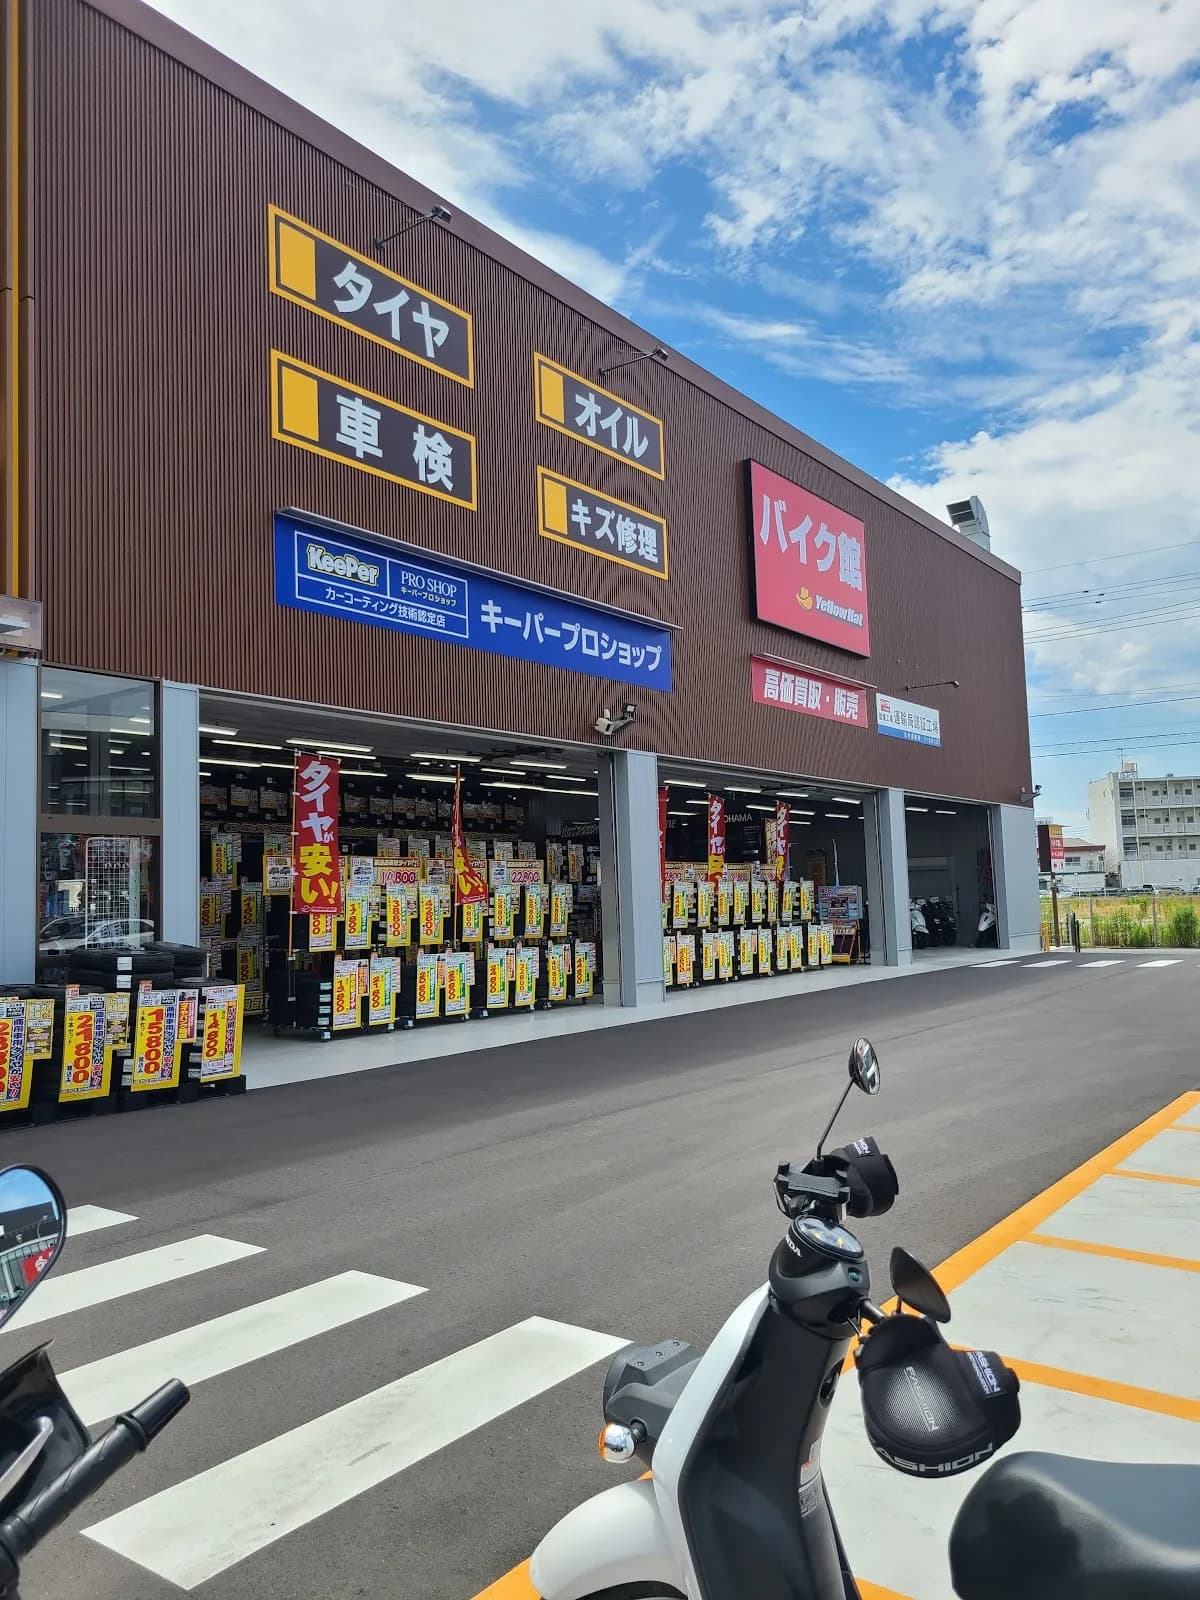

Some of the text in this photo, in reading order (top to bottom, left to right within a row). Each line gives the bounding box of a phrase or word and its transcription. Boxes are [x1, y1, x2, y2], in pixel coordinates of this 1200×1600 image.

[333, 261, 449, 358] タイヤ
[336, 394, 453, 491] 車検
[575, 392, 648, 458] オイル
[571, 499, 658, 564] キズ修理
[760, 494, 862, 591] バイク館
[307, 543, 379, 587] KeePer
[402, 571, 457, 597] PRO SHOP
[326, 587, 446, 628] カーコーティング技術認定店
[401, 587, 456, 607] キーパープロショップ
[481, 600, 661, 671] キーパープロショップ
[764, 668, 858, 720] 高価買取・販売
[785, 1234, 802, 1258] NDA
[976, 1351, 1001, 1393] ASHION
[873, 1442, 993, 1473] ASHION
